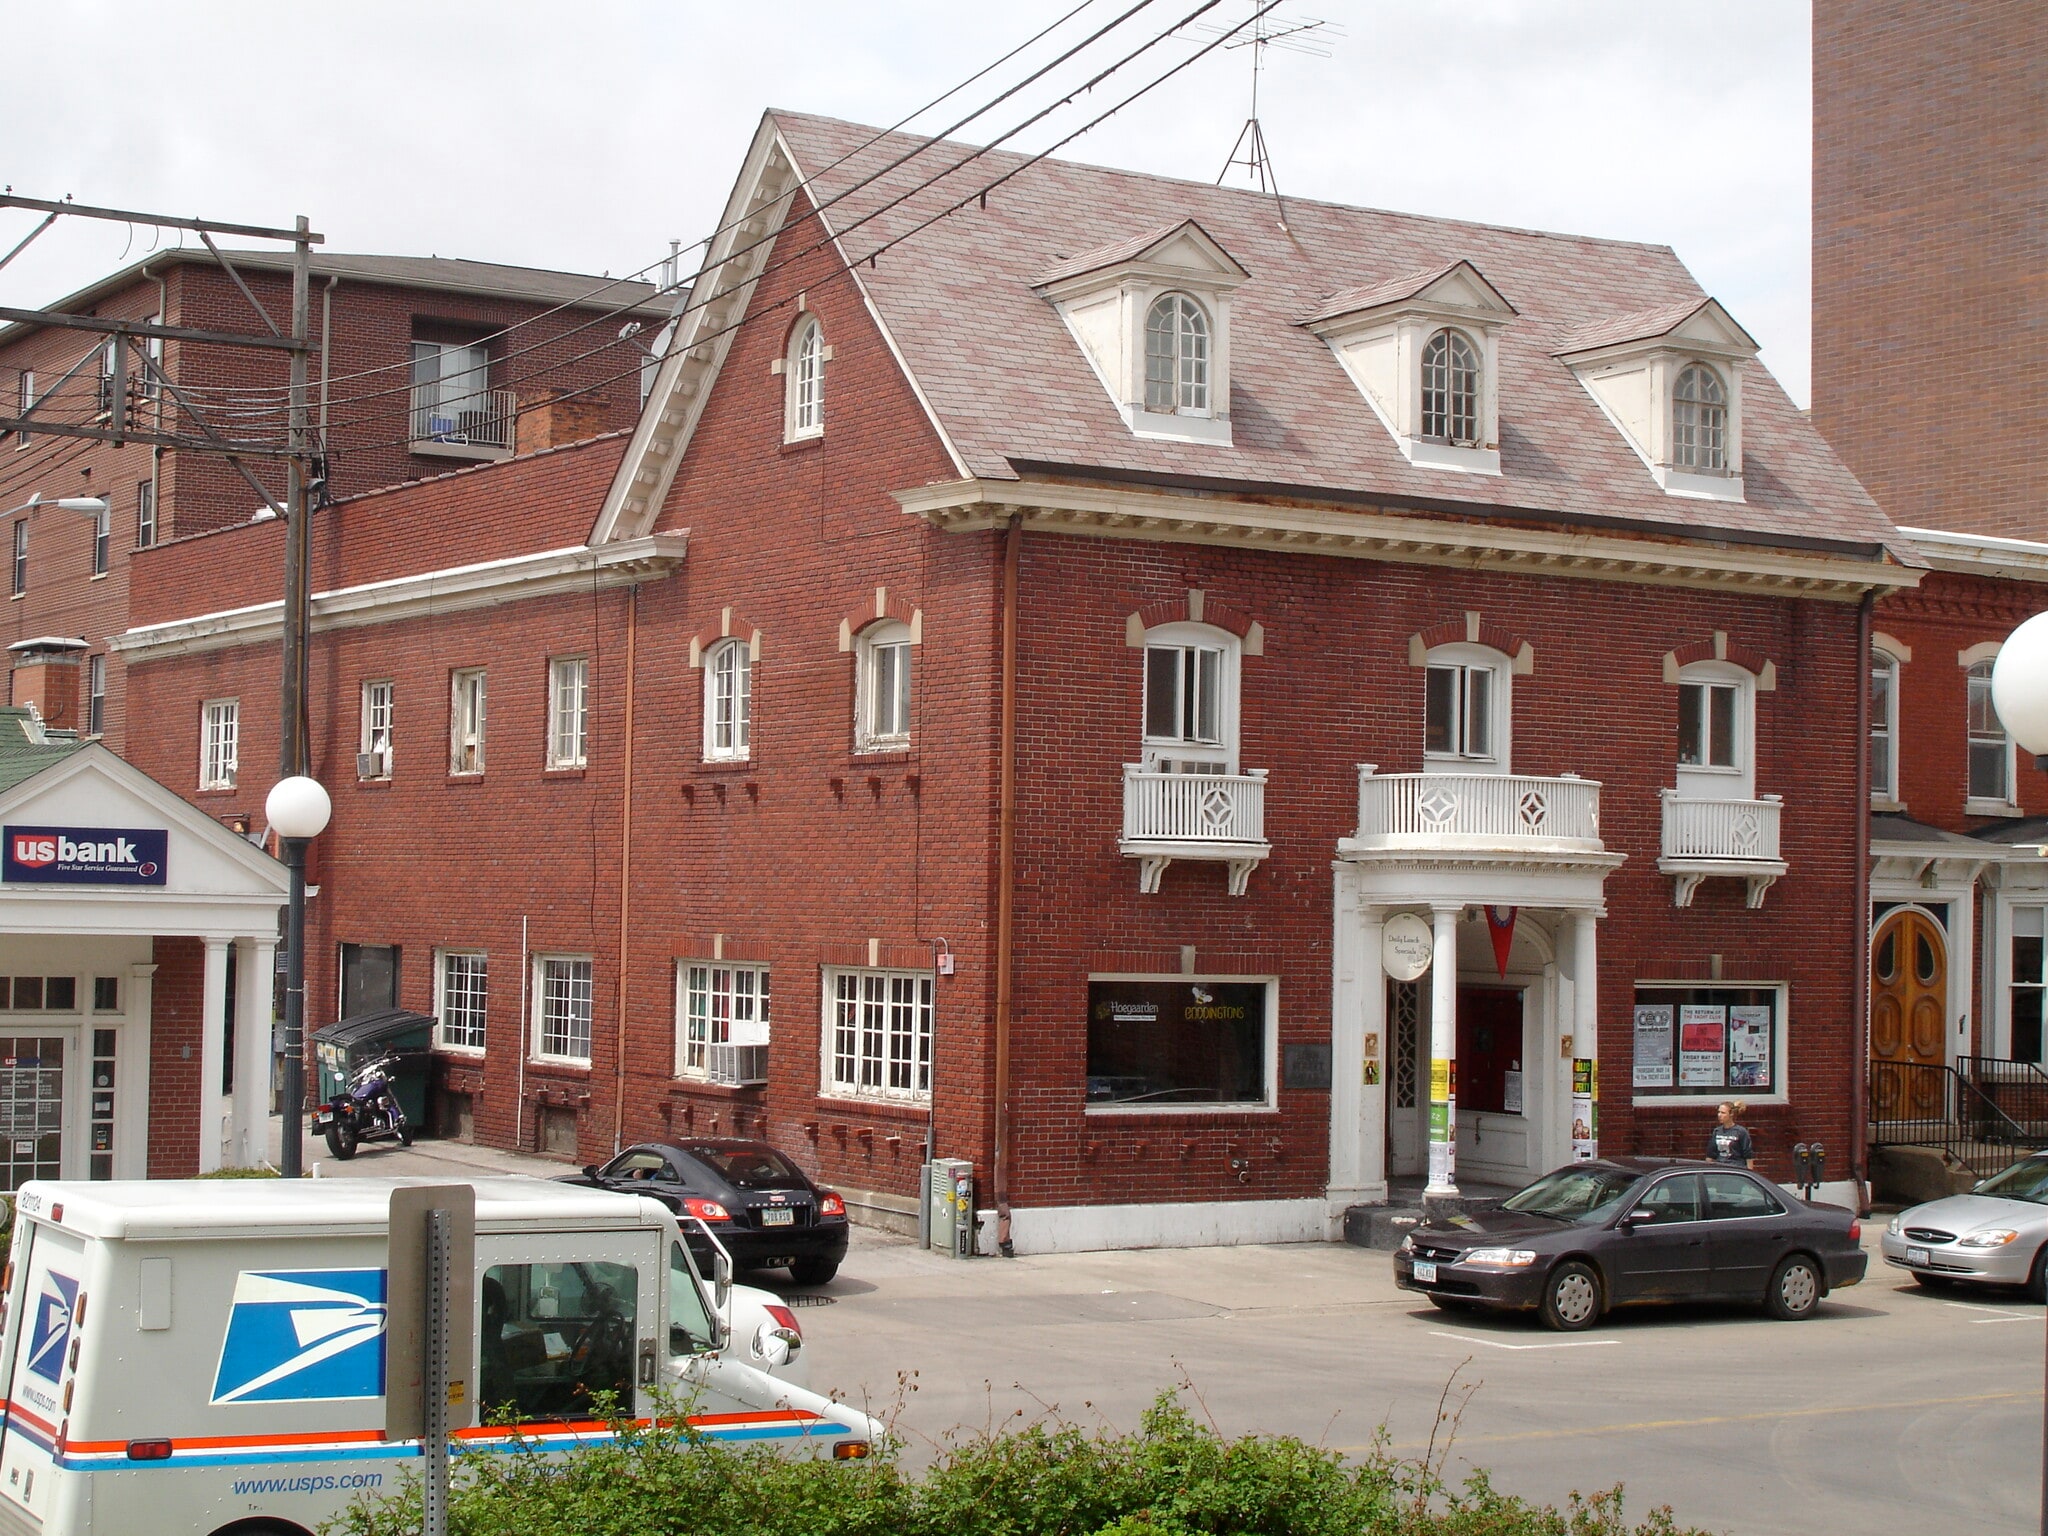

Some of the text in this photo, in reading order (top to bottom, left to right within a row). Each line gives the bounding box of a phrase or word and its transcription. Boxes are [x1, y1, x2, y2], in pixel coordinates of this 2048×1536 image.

[57, 863, 71, 871] Five
[84, 864, 105, 872] Service
[105, 864, 138, 873] Guaranteed
[1110, 1001, 1159, 1015] Hoegaarden
[234, 1473, 383, 1495] www.usps.com
